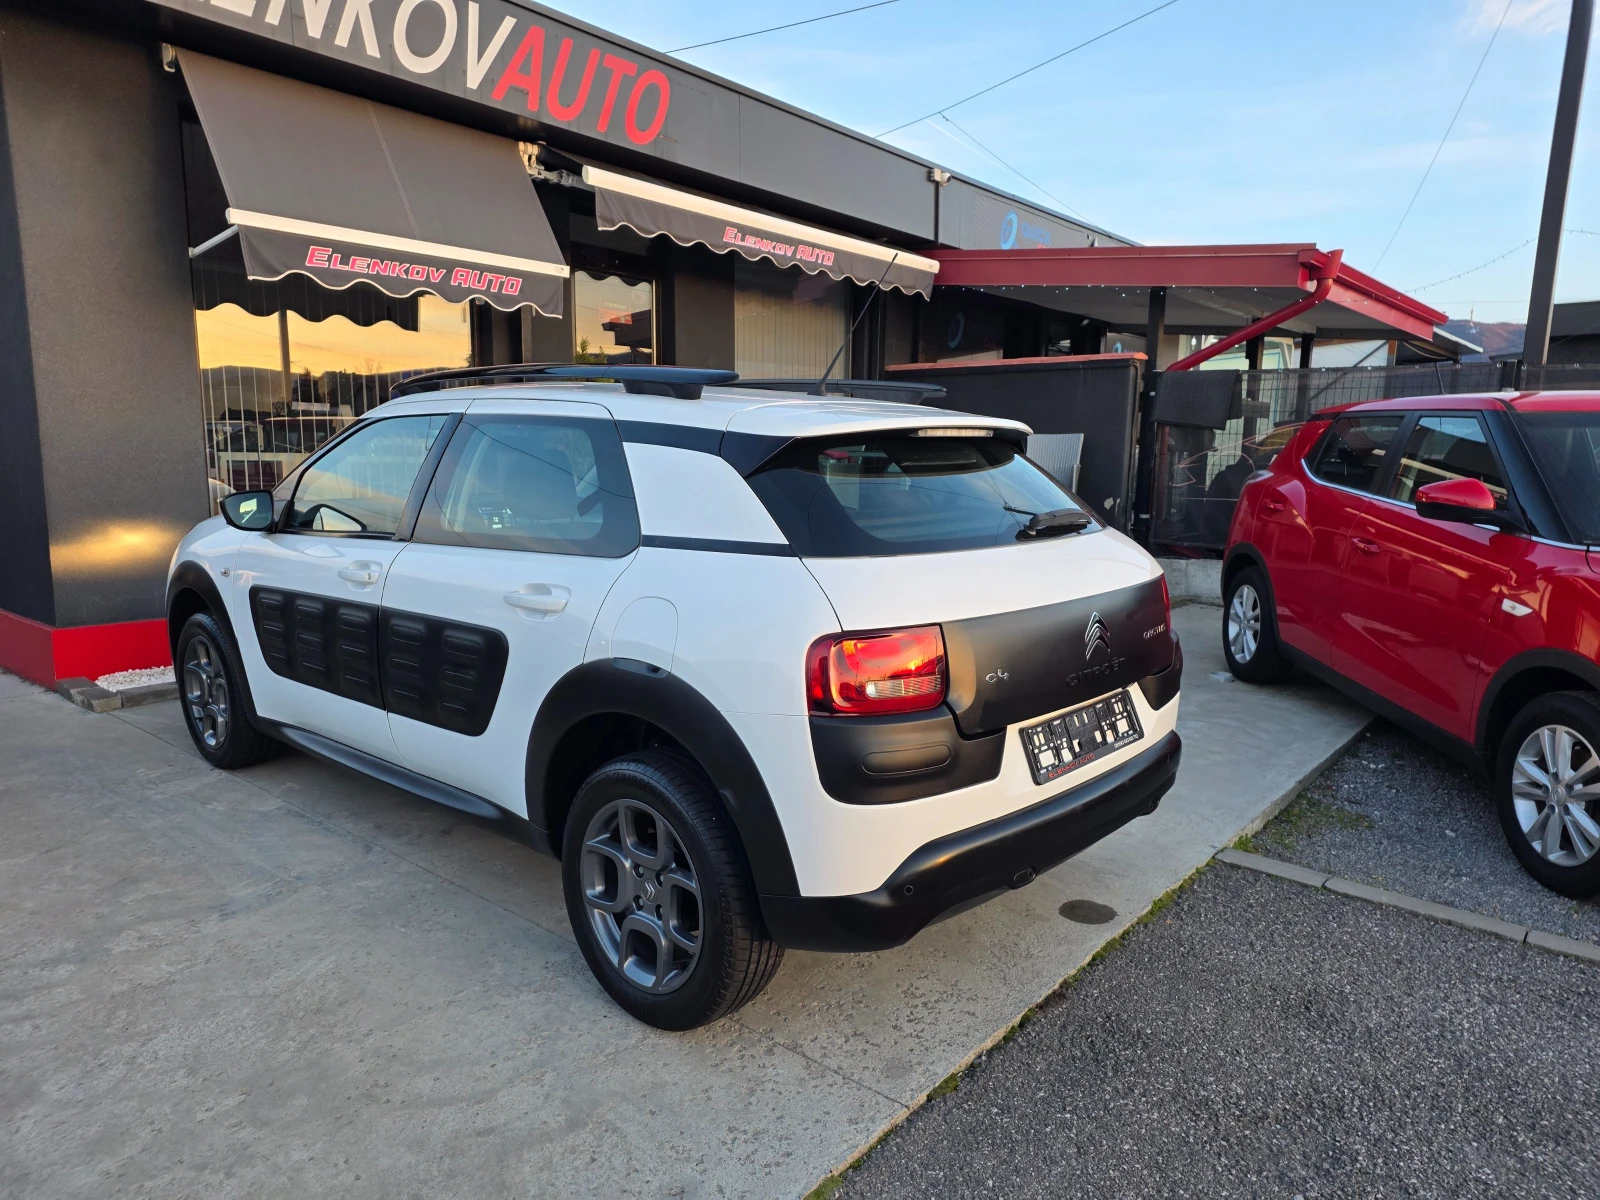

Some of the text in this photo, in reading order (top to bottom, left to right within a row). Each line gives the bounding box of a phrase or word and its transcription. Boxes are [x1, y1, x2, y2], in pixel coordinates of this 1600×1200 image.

[723, 226, 835, 266] ELENKOV AUTO
[305, 245, 523, 296] ELENKOV AUTO
[985, 668, 1010, 683] C4
[1066, 657, 1127, 687] CITROËN
